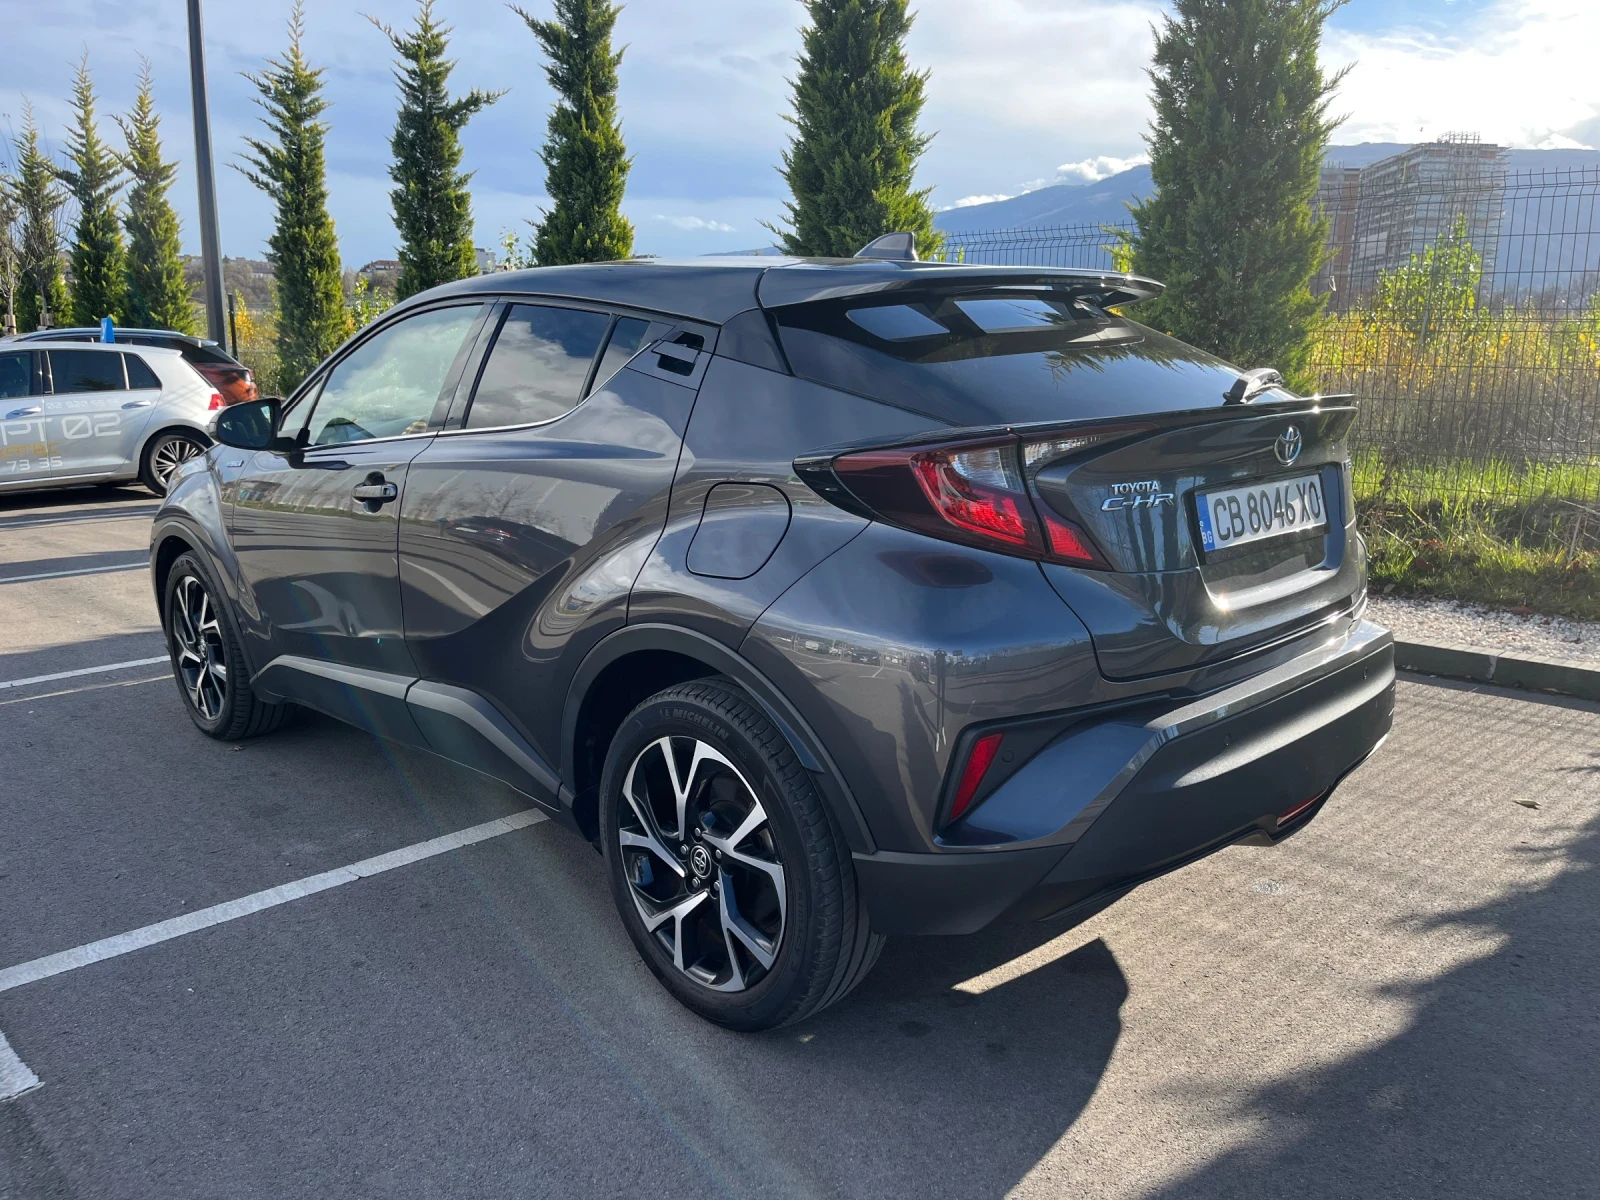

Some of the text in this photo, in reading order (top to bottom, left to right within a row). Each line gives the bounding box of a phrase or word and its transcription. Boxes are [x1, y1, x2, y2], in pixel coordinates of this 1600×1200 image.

[61, 412, 122, 440] 02
[6, 456, 63, 472] 73 35
[1111, 480, 1160, 495] TOYOTA
[1101, 493, 1175, 512] C-HR
[1213, 481, 1321, 541] CB 8046 XO
[1202, 531, 1213, 544] BG
[672, 708, 730, 741] MICHELIN
